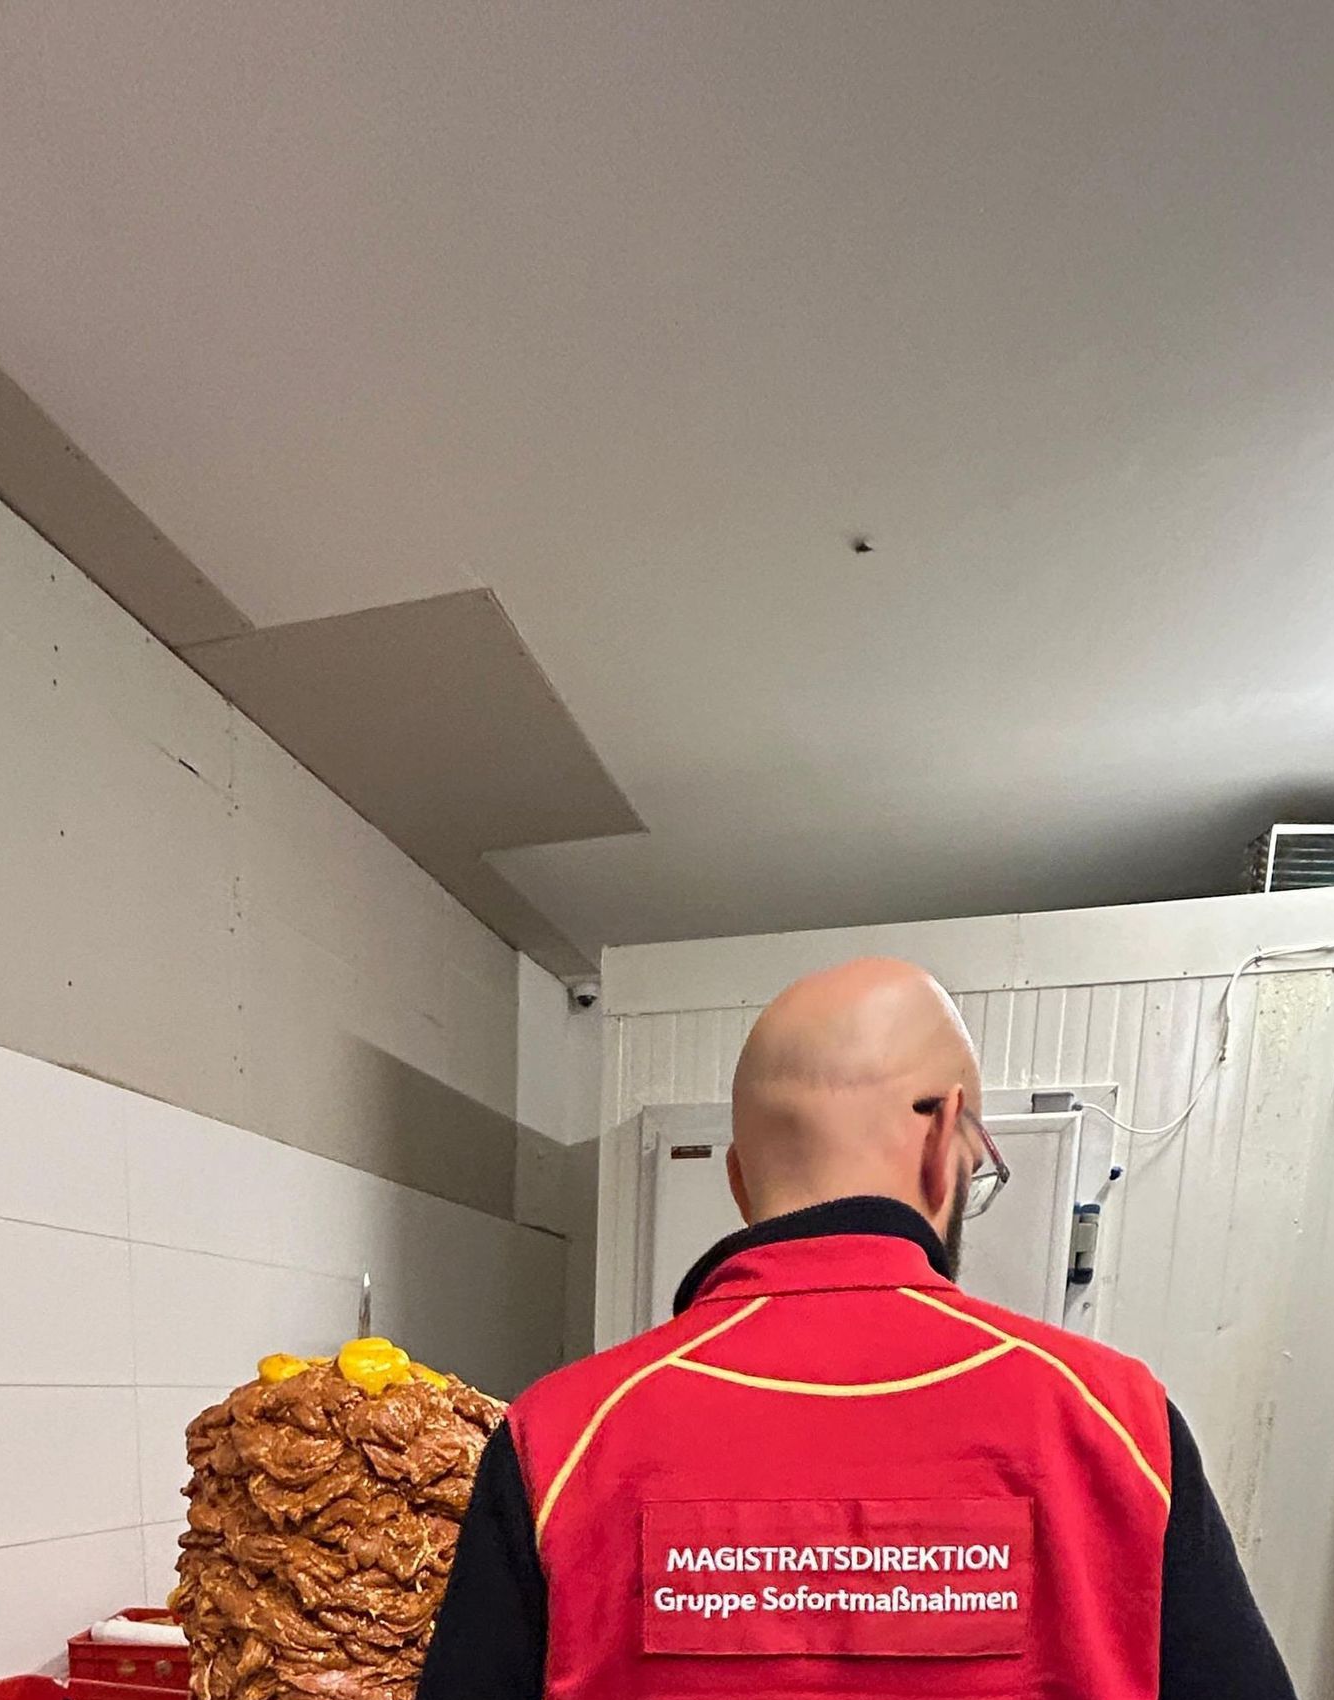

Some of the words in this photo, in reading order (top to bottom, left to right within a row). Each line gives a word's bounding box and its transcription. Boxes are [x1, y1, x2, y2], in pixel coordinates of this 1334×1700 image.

[667, 1545, 1010, 1572] MAGISTRATSDIREKTION
[654, 1587, 757, 1618] Gruppe
[762, 1585, 1018, 1612] Sofortmaßnahmen
